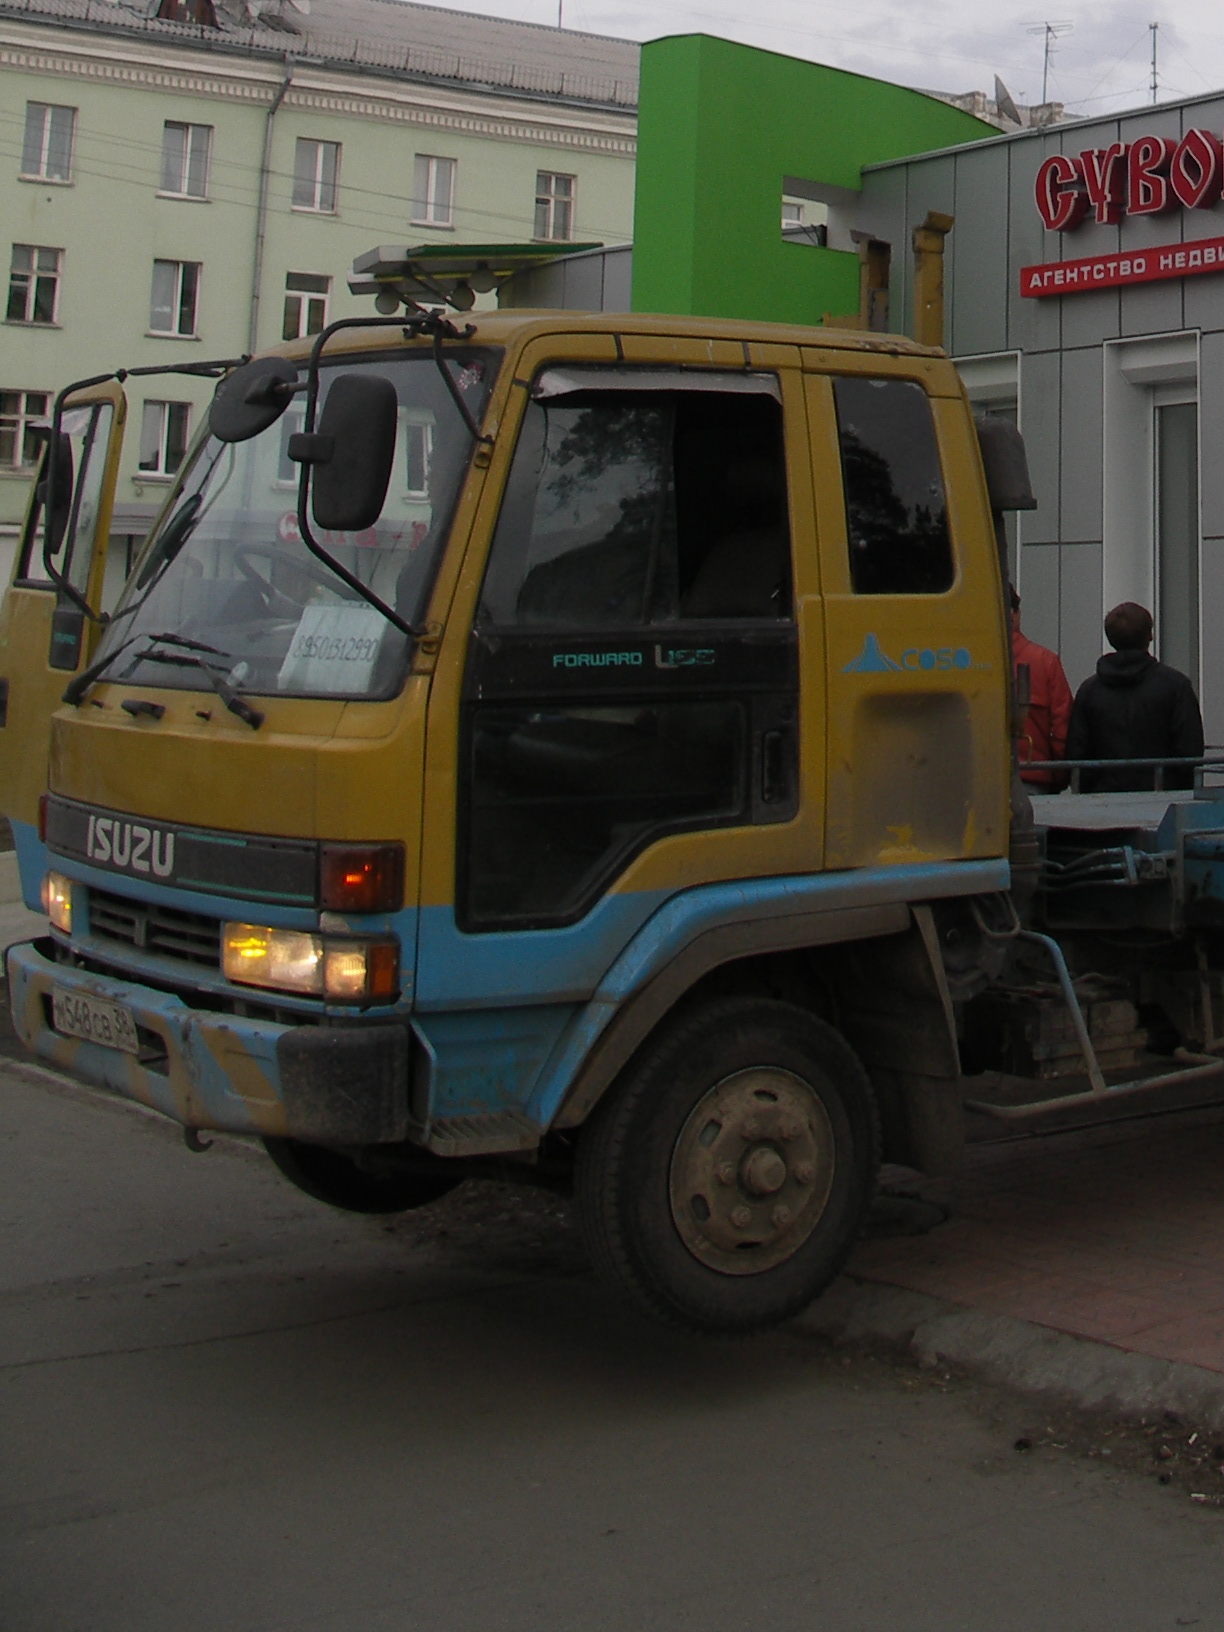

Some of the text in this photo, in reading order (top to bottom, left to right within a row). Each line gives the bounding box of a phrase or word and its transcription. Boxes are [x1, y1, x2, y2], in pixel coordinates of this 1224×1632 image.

[1029, 258, 1146, 289] АГЕНТСТВО
[553, 652, 643, 668] FORWARD
[87, 815, 175, 877] ISUZU
